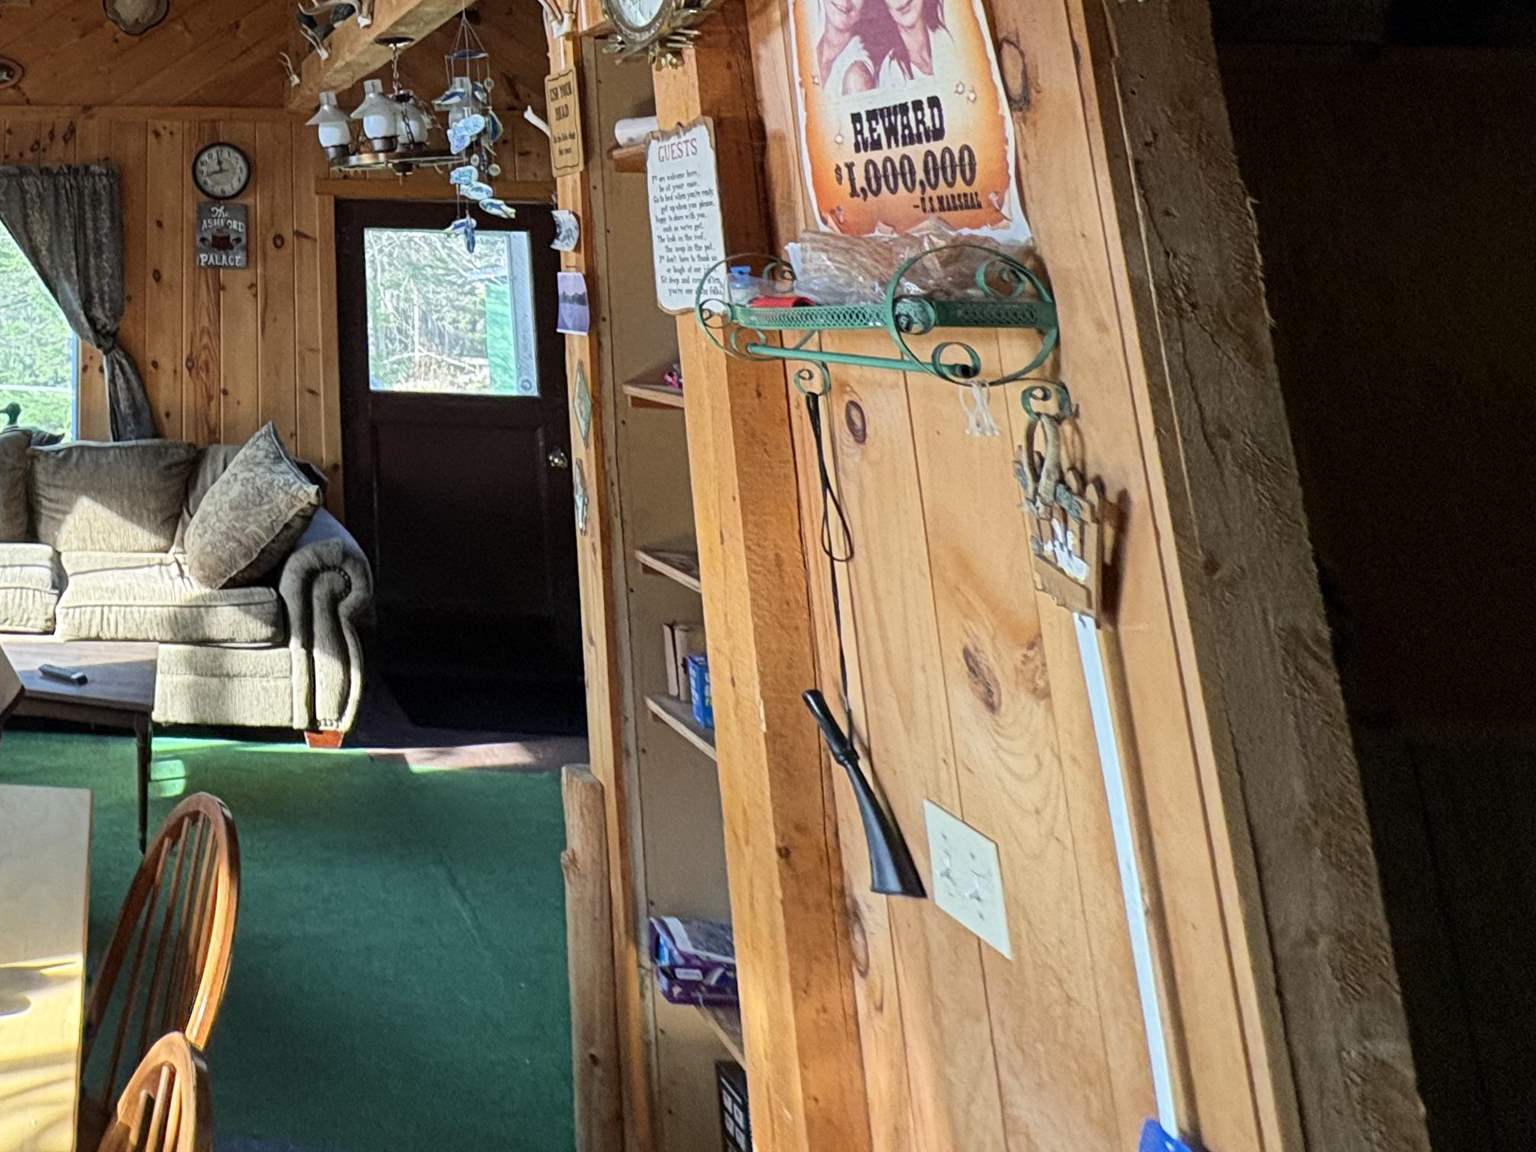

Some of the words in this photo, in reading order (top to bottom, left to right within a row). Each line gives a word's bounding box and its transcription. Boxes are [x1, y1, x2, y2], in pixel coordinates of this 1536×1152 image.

[850, 96, 945, 153] REWARD
[658, 138, 698, 162] GUESTS
[834, 144, 977, 202] $1,000,000
[211, 205, 230, 218] The
[937, 192, 982, 212] MARSHAL
[201, 218, 245, 232] ASHFORD
[199, 254, 241, 266] PALACE
